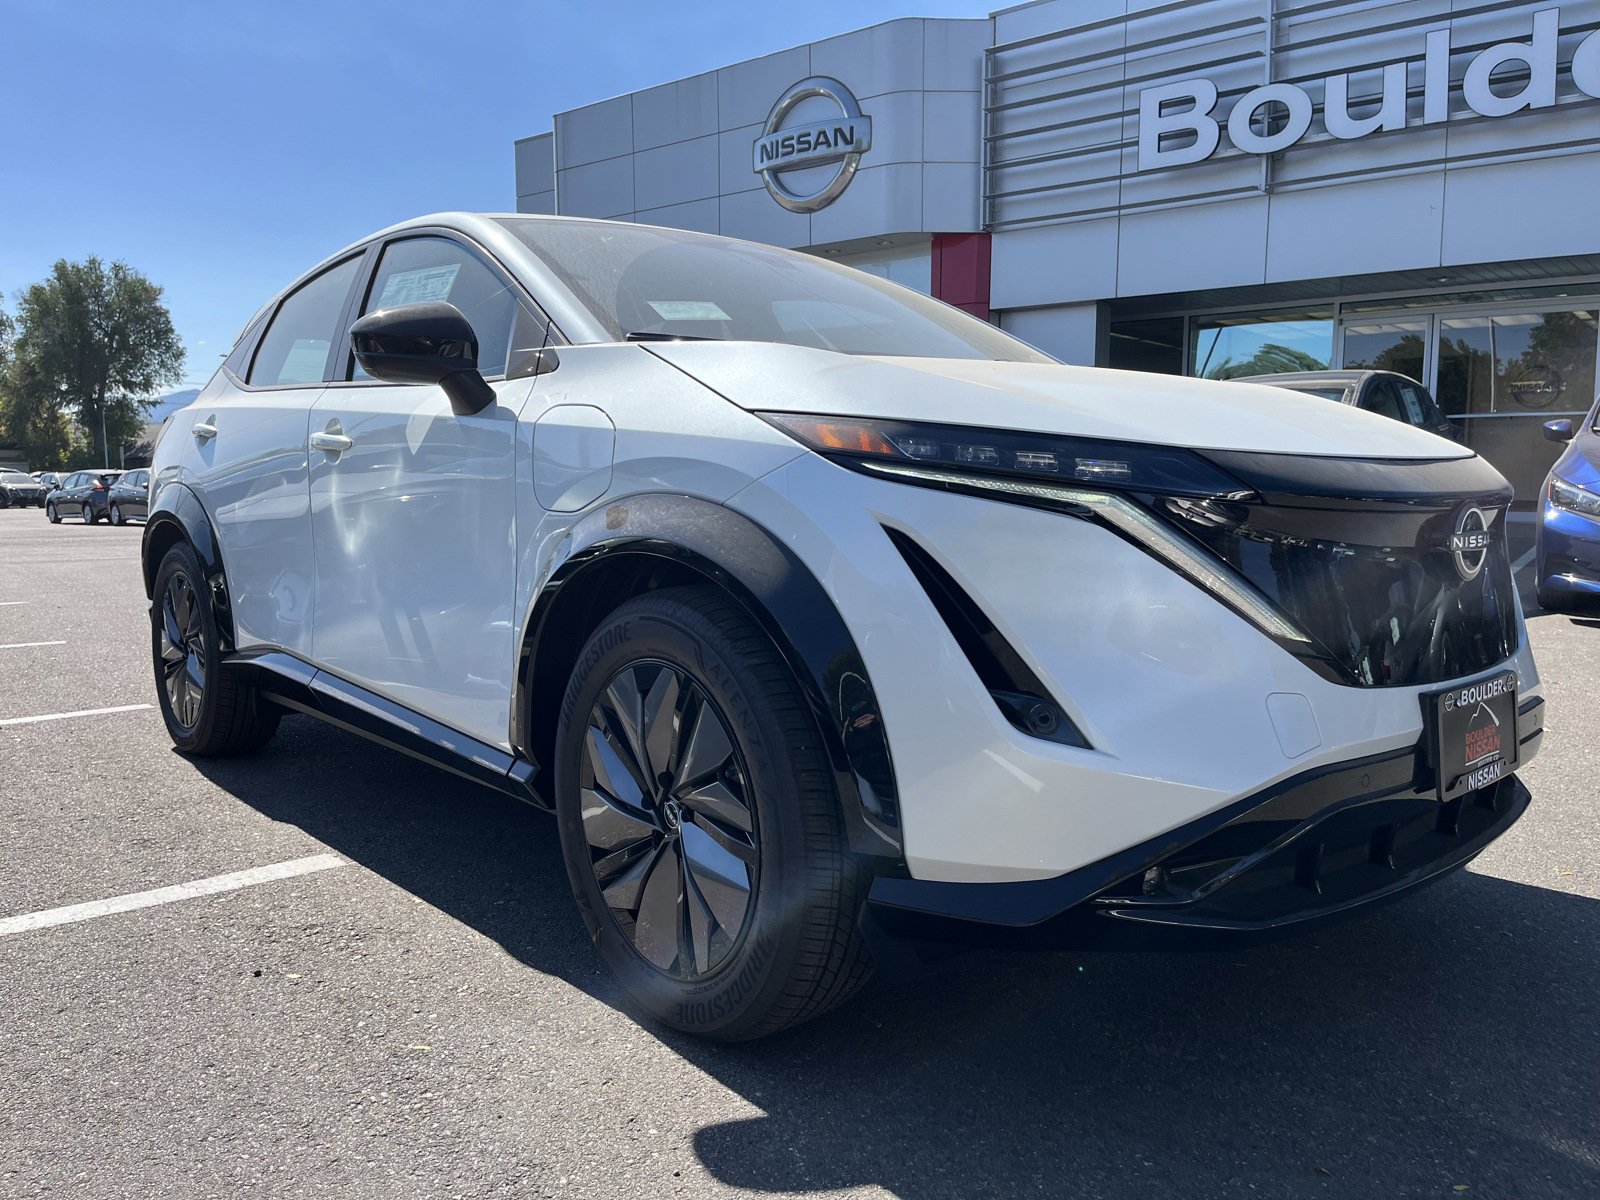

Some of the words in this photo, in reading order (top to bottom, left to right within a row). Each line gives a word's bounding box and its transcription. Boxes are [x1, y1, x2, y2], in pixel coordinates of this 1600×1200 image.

[760, 125, 854, 163] NISSAN
[560, 621, 632, 733] BRIDGESTONE
[1461, 680, 1503, 706] BOULDER
[1465, 724, 1497, 744] BOULDER
[1465, 735, 1500, 763] NISSAN
[1468, 763, 1500, 791] NISSAN
